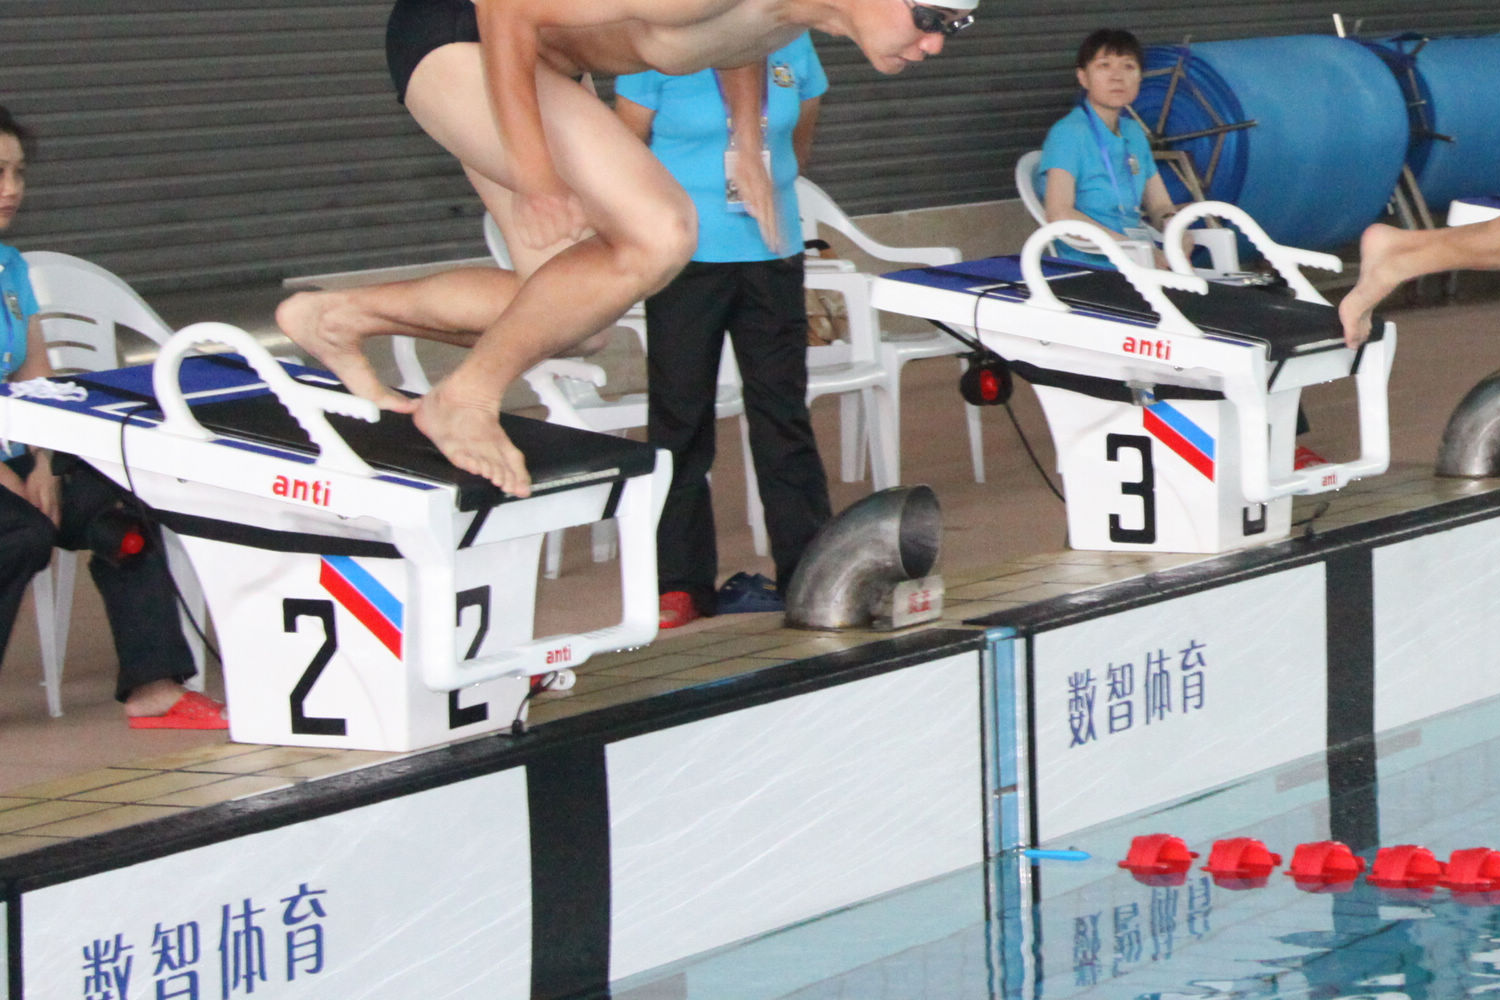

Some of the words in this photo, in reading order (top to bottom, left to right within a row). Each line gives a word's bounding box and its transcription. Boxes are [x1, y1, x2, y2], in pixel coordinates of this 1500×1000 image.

[1122, 335, 1171, 360] anti
[272, 474, 331, 507] anti
[1106, 433, 1156, 544] 3
[283, 597, 347, 736] 2
[545, 644, 572, 665] anti
[1067, 639, 1207, 749] 数智体育
